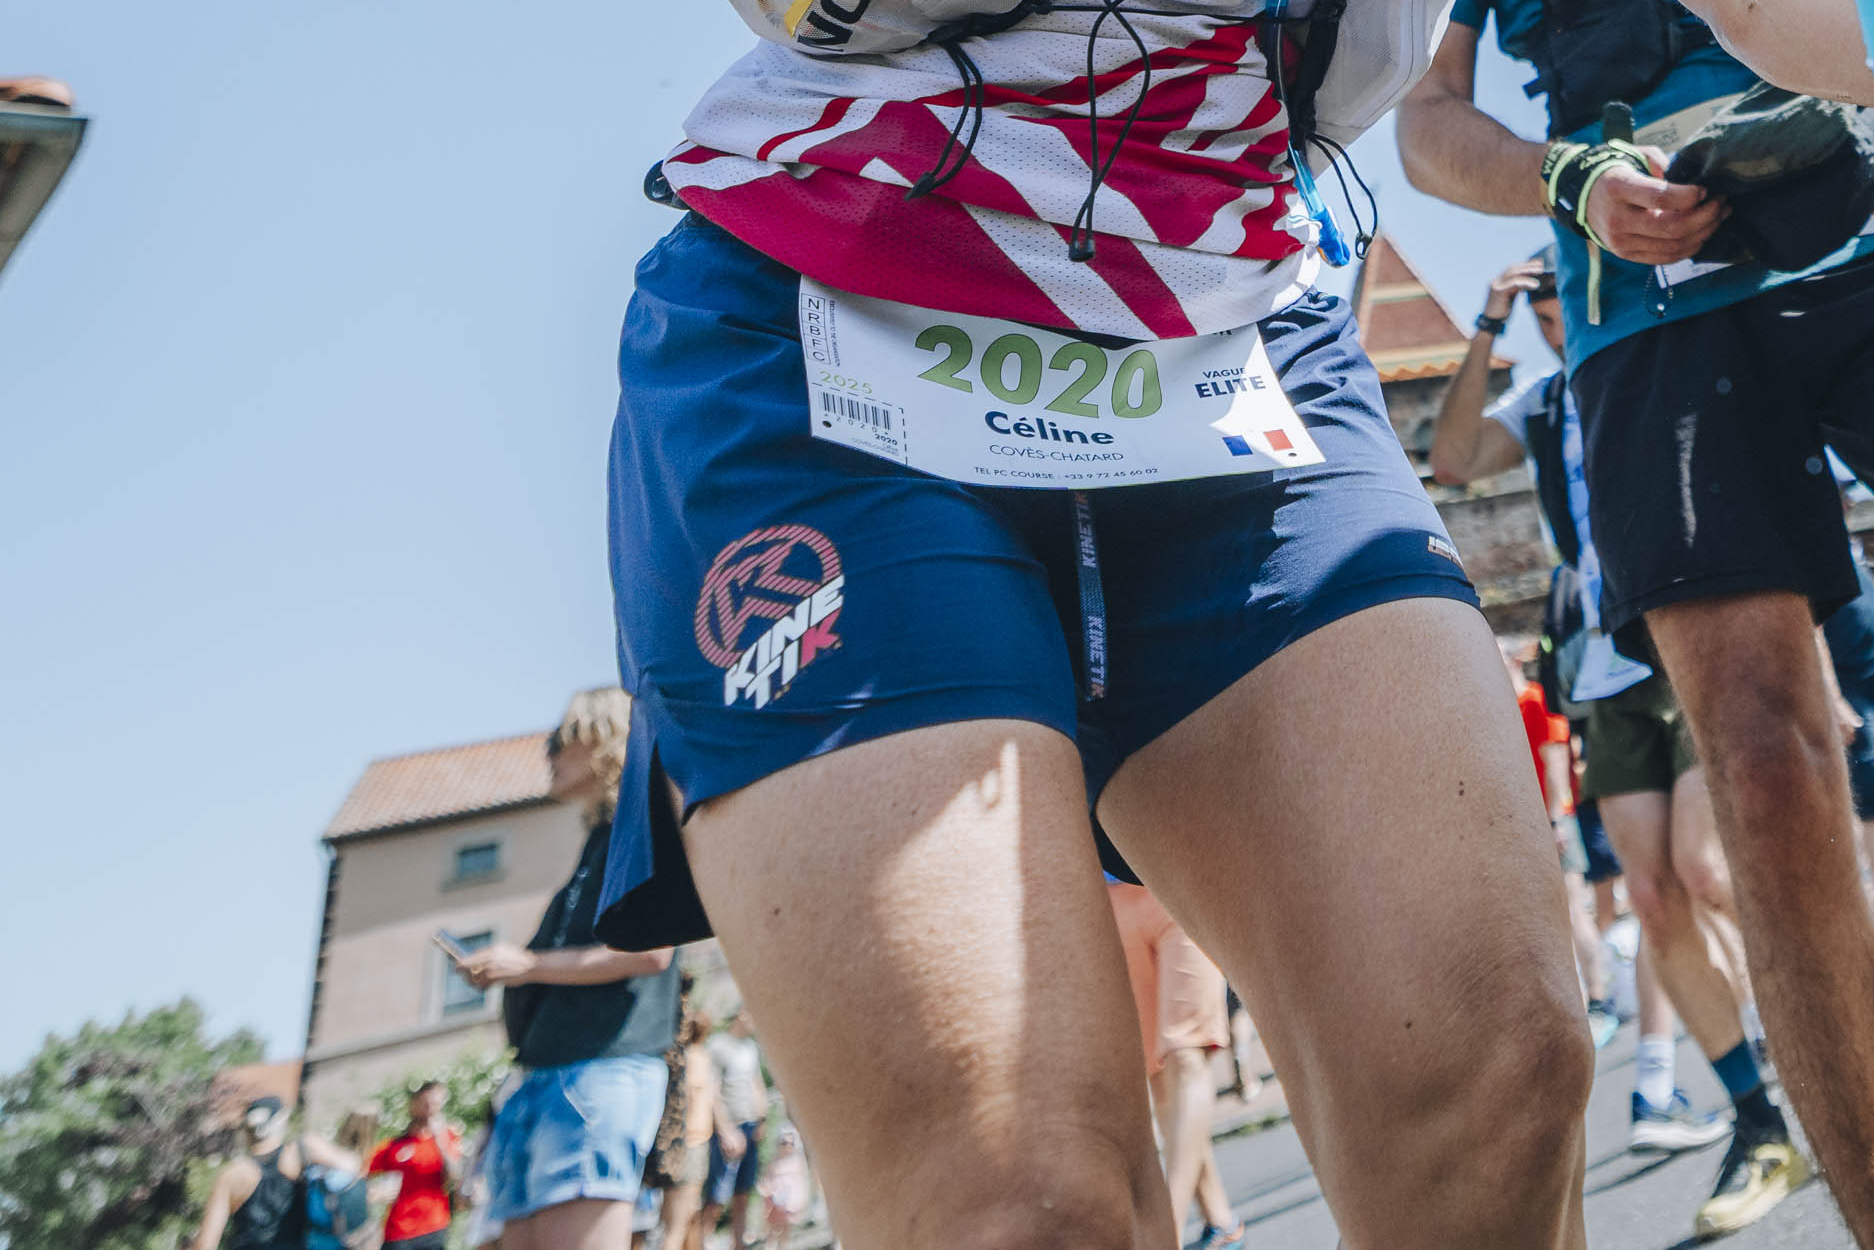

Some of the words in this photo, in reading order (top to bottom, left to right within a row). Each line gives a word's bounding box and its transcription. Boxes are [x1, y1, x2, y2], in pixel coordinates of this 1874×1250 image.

[819, 370, 873, 395] 2025
[914, 324, 1163, 419] 2020
[1194, 375, 1267, 399] ELITE
[984, 410, 1115, 445] Céline
[988, 443, 1124, 463] COVÈS-CHATARD
[973, 466, 991, 476] TEL
[994, 469, 1008, 478] PC
[1010, 470, 1054, 480] COURSE
